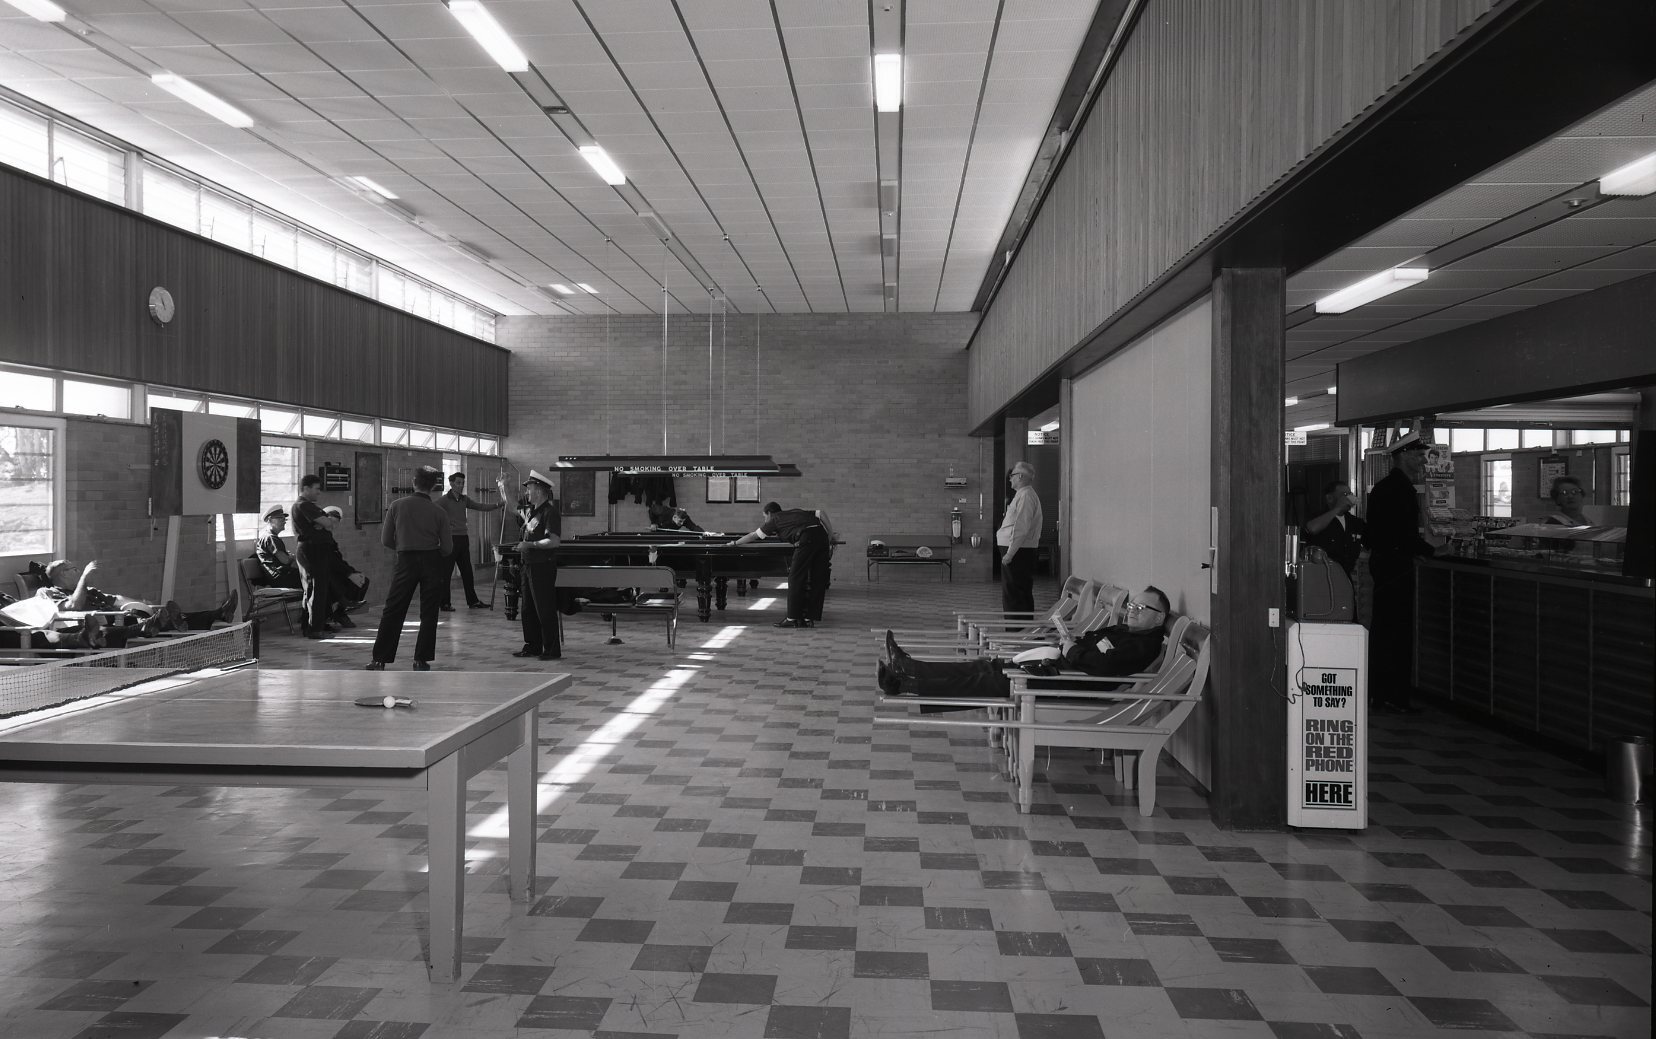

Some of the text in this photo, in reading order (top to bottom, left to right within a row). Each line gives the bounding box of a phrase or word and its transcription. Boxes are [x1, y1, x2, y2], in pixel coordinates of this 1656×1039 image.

[1321, 673, 1337, 684] GOT
[1305, 685, 1353, 696] SOMETHING
[1313, 697, 1346, 708] TO SAY?
[1306, 719, 1353, 732] RING
[1306, 732, 1353, 746] ON THE
[1306, 746, 1353, 759] RED
[1306, 759, 1353, 772] PHONE
[1306, 783, 1352, 804] HERE
